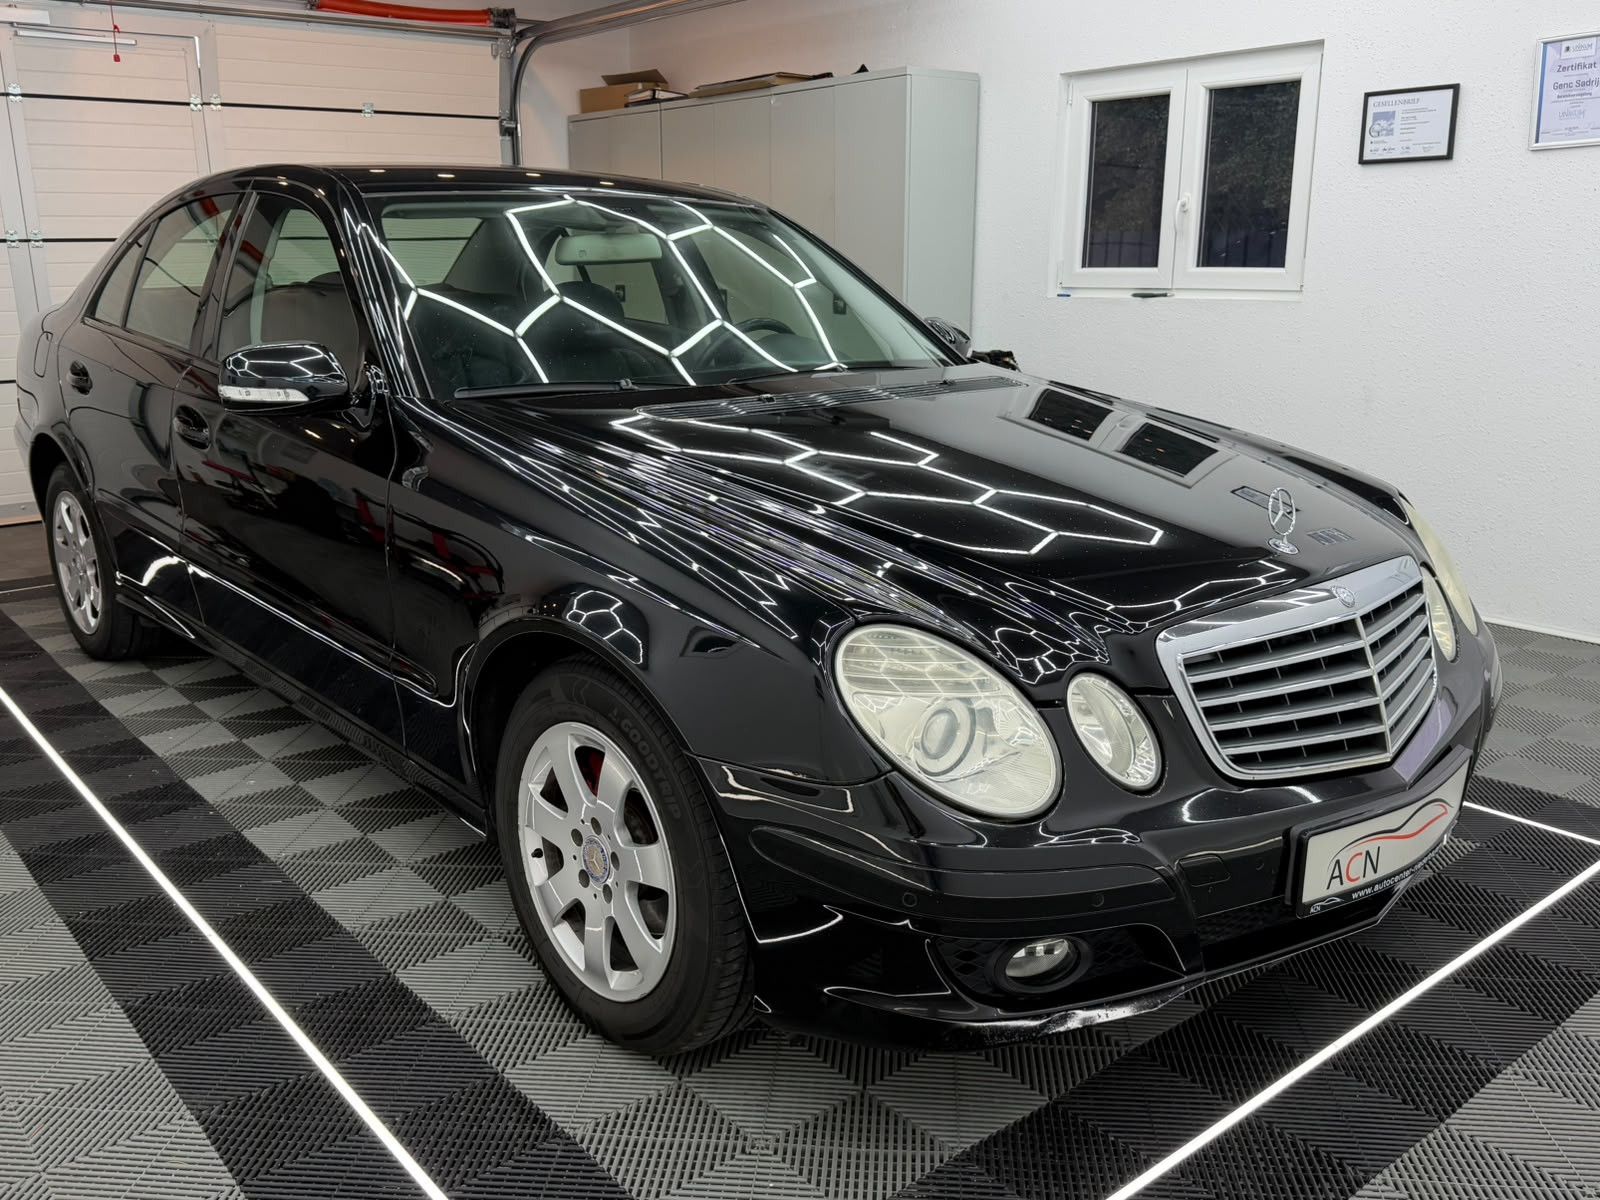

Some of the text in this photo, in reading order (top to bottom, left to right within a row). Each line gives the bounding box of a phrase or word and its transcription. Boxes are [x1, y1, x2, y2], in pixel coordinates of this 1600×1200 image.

[1556, 61, 1597, 73] Zertifikat
[1552, 81, 1573, 91] Genc
[620, 719, 681, 819] GOODTRIP
[1326, 846, 1381, 890] ACN
